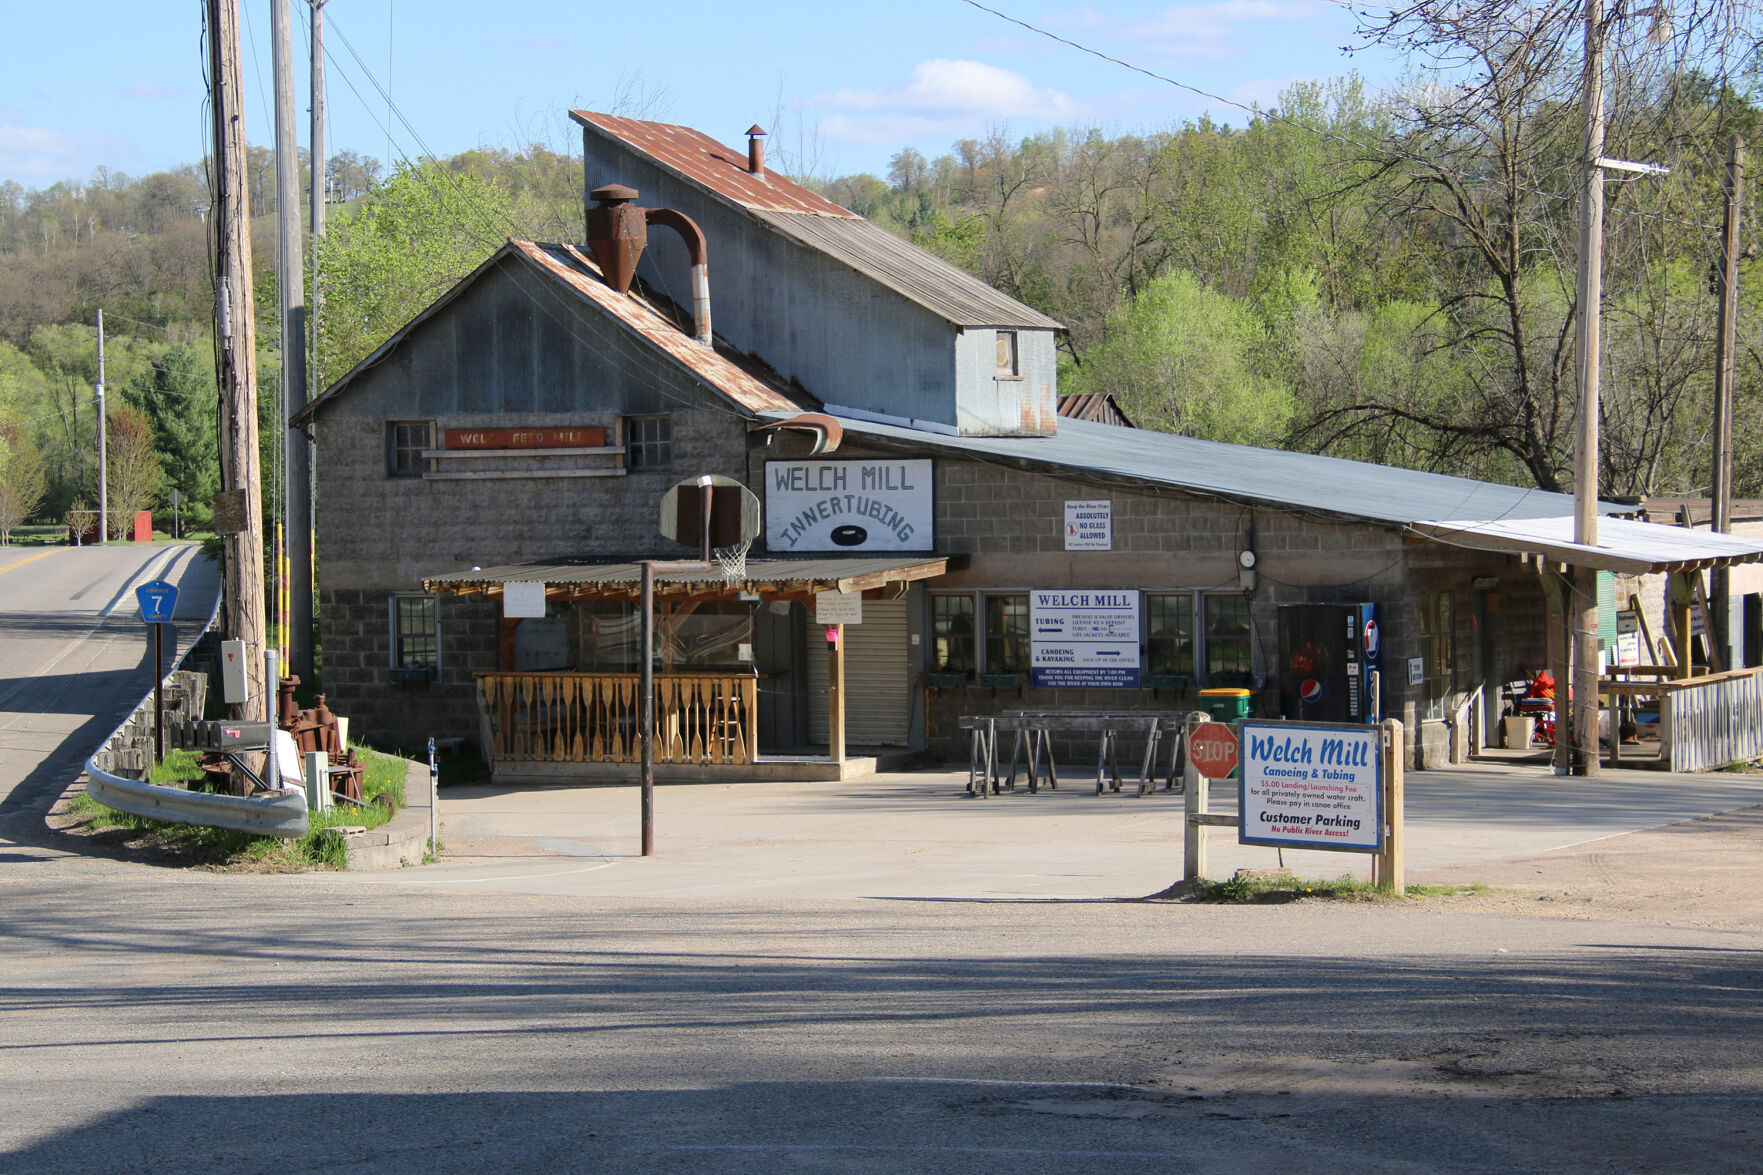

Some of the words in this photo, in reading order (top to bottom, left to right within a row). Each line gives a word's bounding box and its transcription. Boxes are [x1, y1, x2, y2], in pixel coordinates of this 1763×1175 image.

[775, 466, 847, 491] WELCH
[862, 465, 914, 490] MILL
[780, 494, 915, 547] INNERTUBING
[152, 596, 162, 612] 7
[1038, 594, 1090, 606] WELCH
[1094, 594, 1131, 606] MILL
[1193, 740, 1235, 762] STOP
[1250, 734, 1312, 764] Welch
[1320, 738, 1368, 767] Mill
[1264, 766, 1308, 780] Canoeing
[1311, 769, 1318, 778] &
[1322, 769, 1355, 782] Tubing
[1272, 790, 1300, 799] privately
[1282, 782, 1344, 793] Landing/Launching
[1260, 811, 1312, 825] Customer
[1315, 814, 1360, 830] Parking
[1282, 826, 1302, 834] Public
[1305, 827, 1323, 835] River
[1325, 829, 1349, 837] Access!
